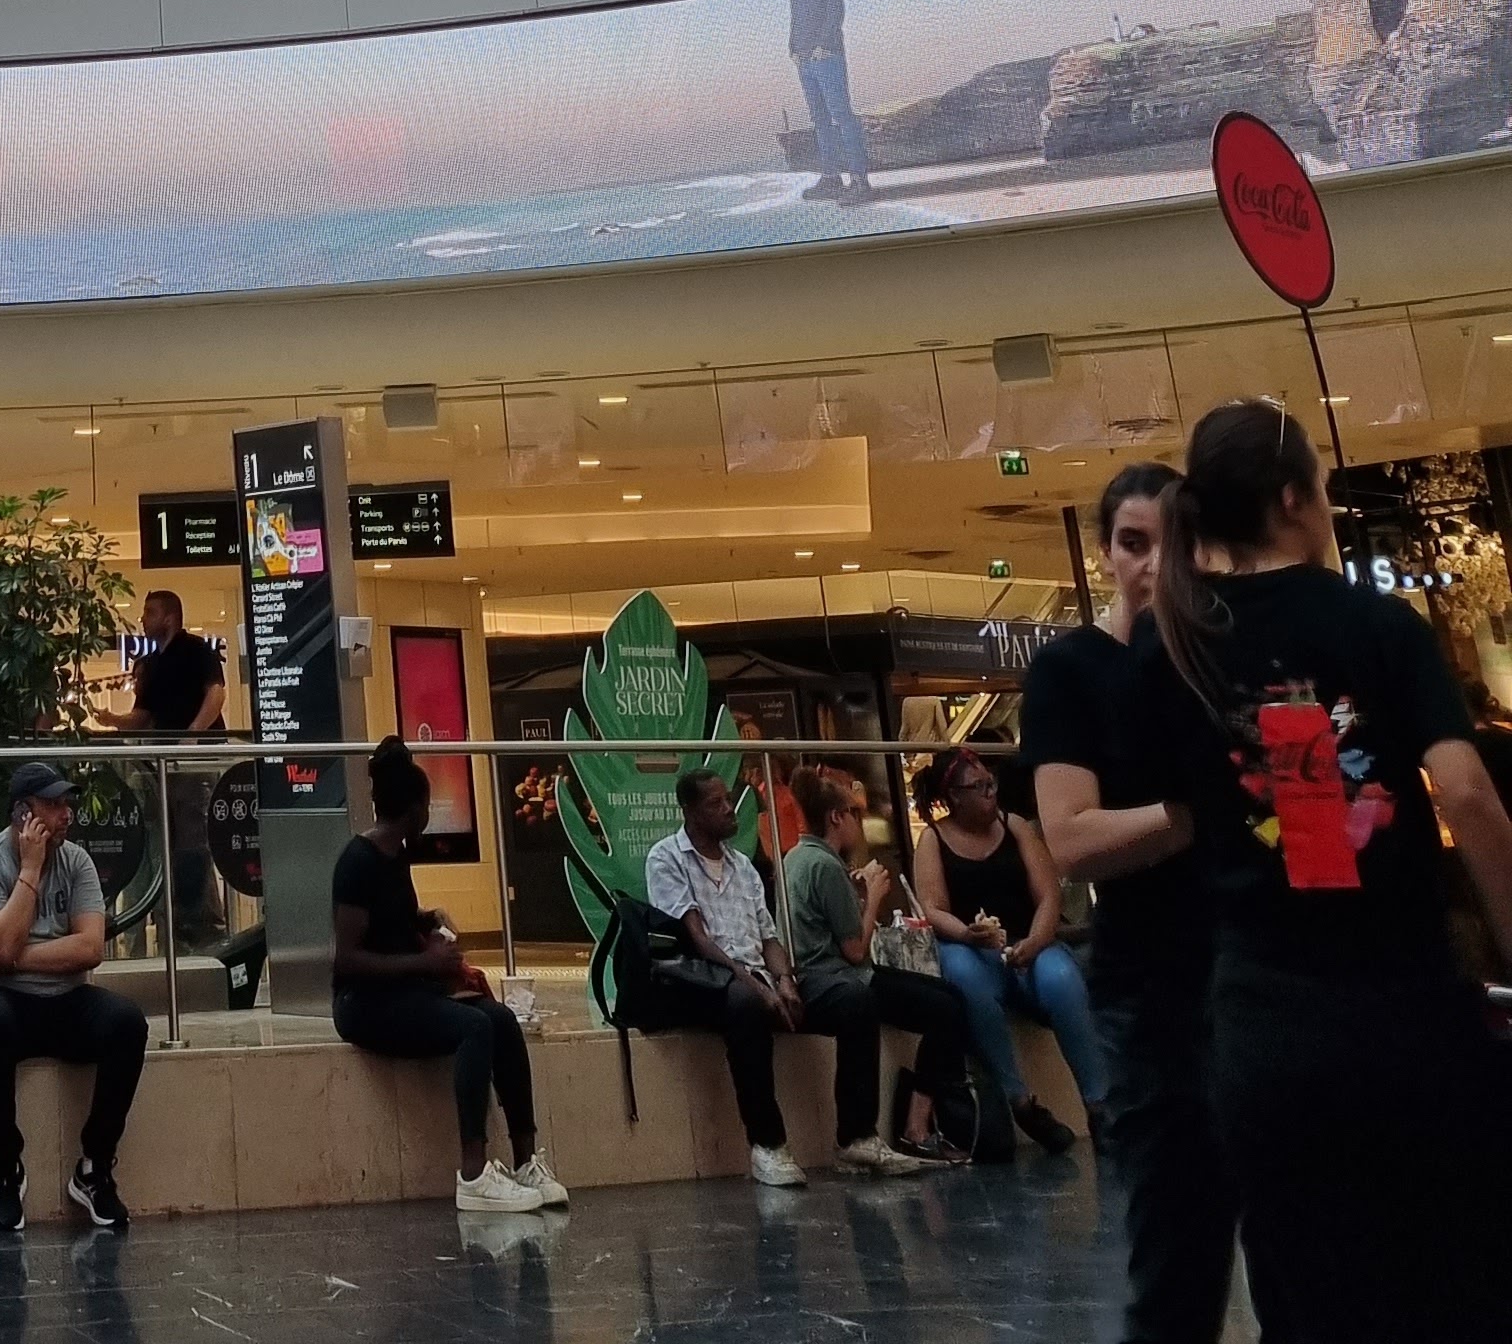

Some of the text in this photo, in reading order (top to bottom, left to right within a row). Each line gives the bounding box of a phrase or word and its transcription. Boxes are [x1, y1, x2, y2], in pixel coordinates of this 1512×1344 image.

[250, 453, 259, 488] 1
[273, 472, 283, 486] Le
[360, 511, 383, 519] Parking
[157, 512, 168, 550] 1
[361, 525, 394, 533] Transports
[615, 665, 686, 692] JARDIN
[616, 692, 684, 716] SECRET
[525, 727, 548, 738] PAUL
[628, 793, 641, 805] LES
